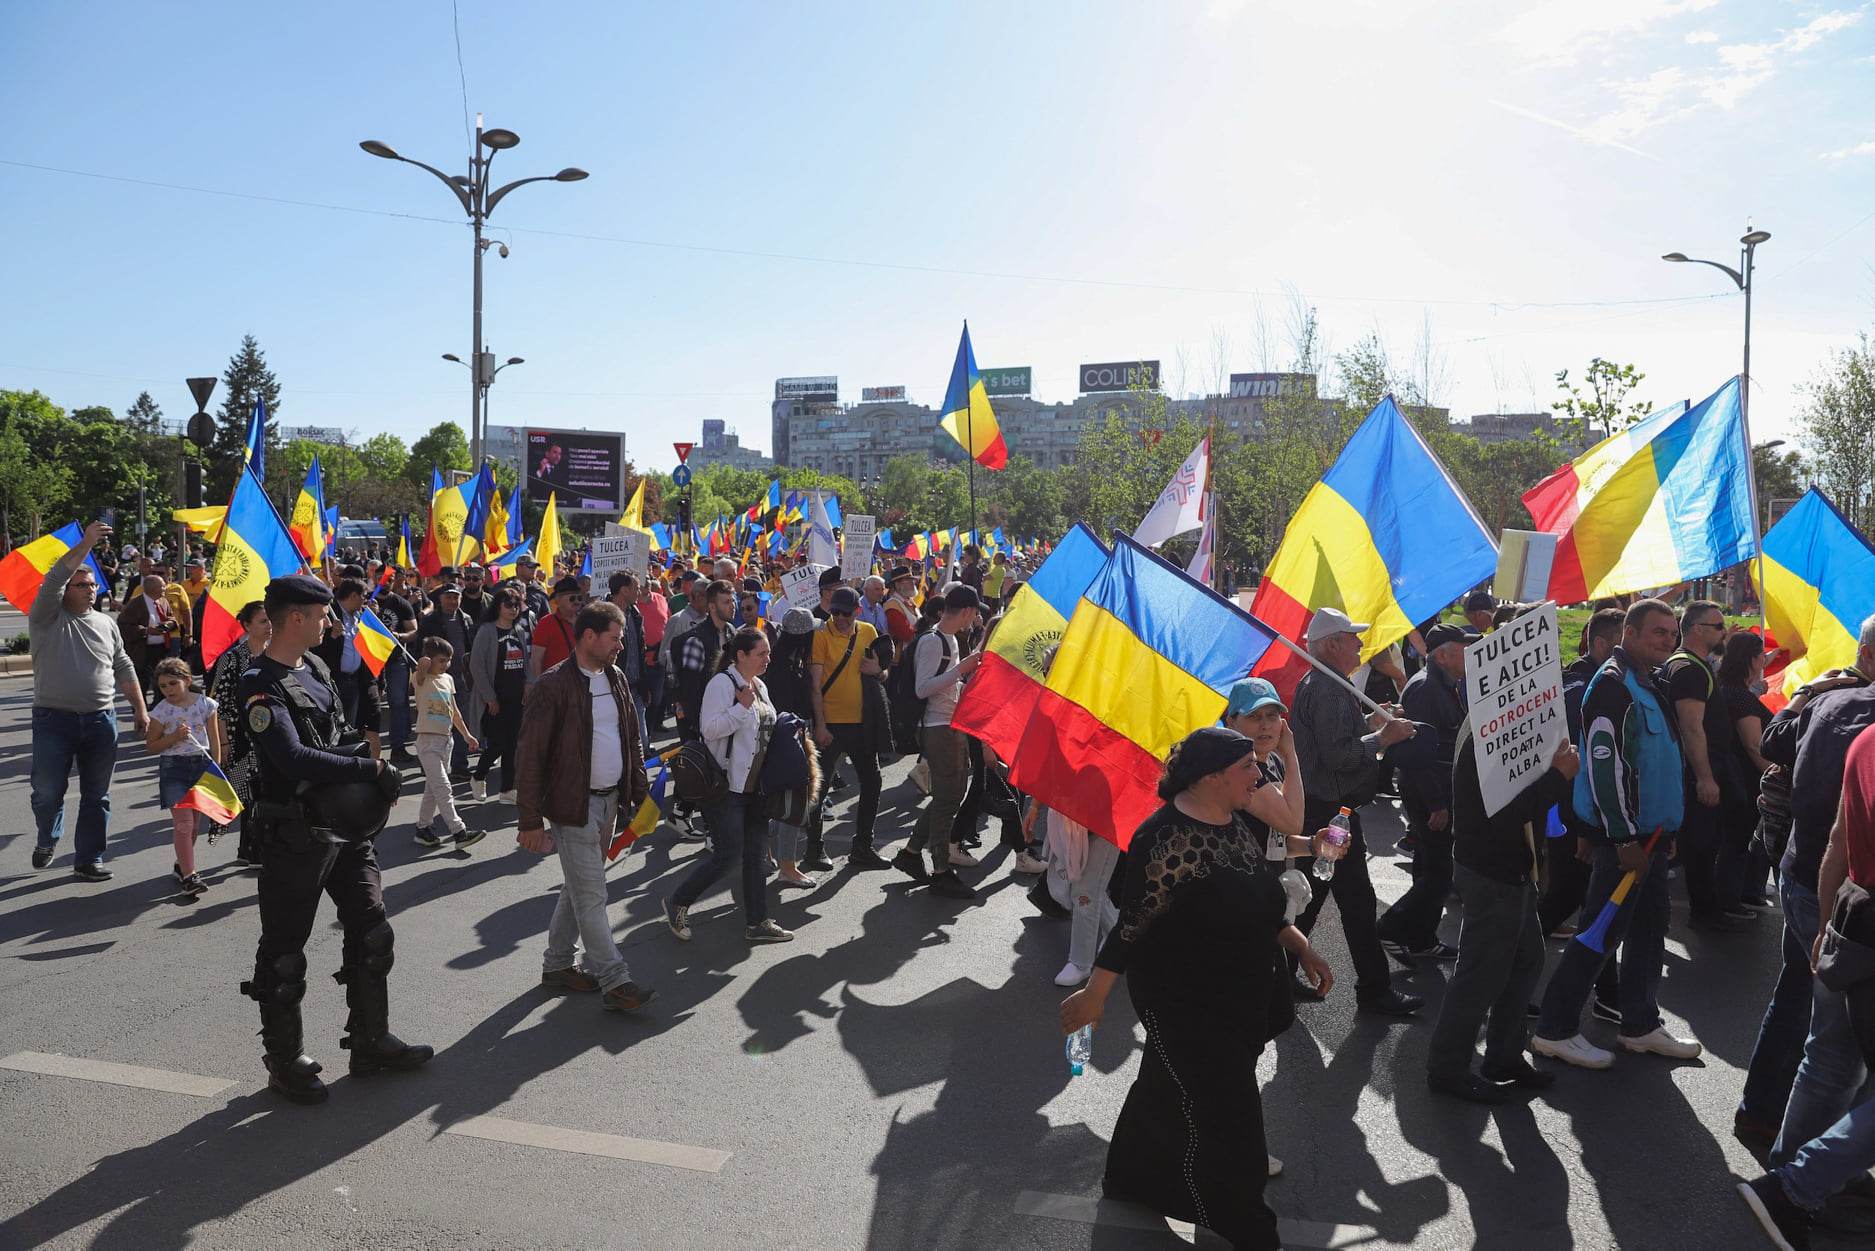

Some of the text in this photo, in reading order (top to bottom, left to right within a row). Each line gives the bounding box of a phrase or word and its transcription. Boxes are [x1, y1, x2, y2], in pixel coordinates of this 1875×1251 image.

[1001, 373, 1027, 386] bet
[530, 435, 546, 444] USR
[850, 520, 871, 532] TULCEA
[600, 540, 629, 553] TULCEA
[1473, 615, 1550, 669] TULCEA
[1479, 643, 1550, 697] E AICI!
[1498, 678, 1537, 709] DE LA
[1480, 685, 1559, 738] COTROCENI
[1486, 707, 1556, 755] DIRECT LA
[1508, 753, 1541, 782] ALBA
